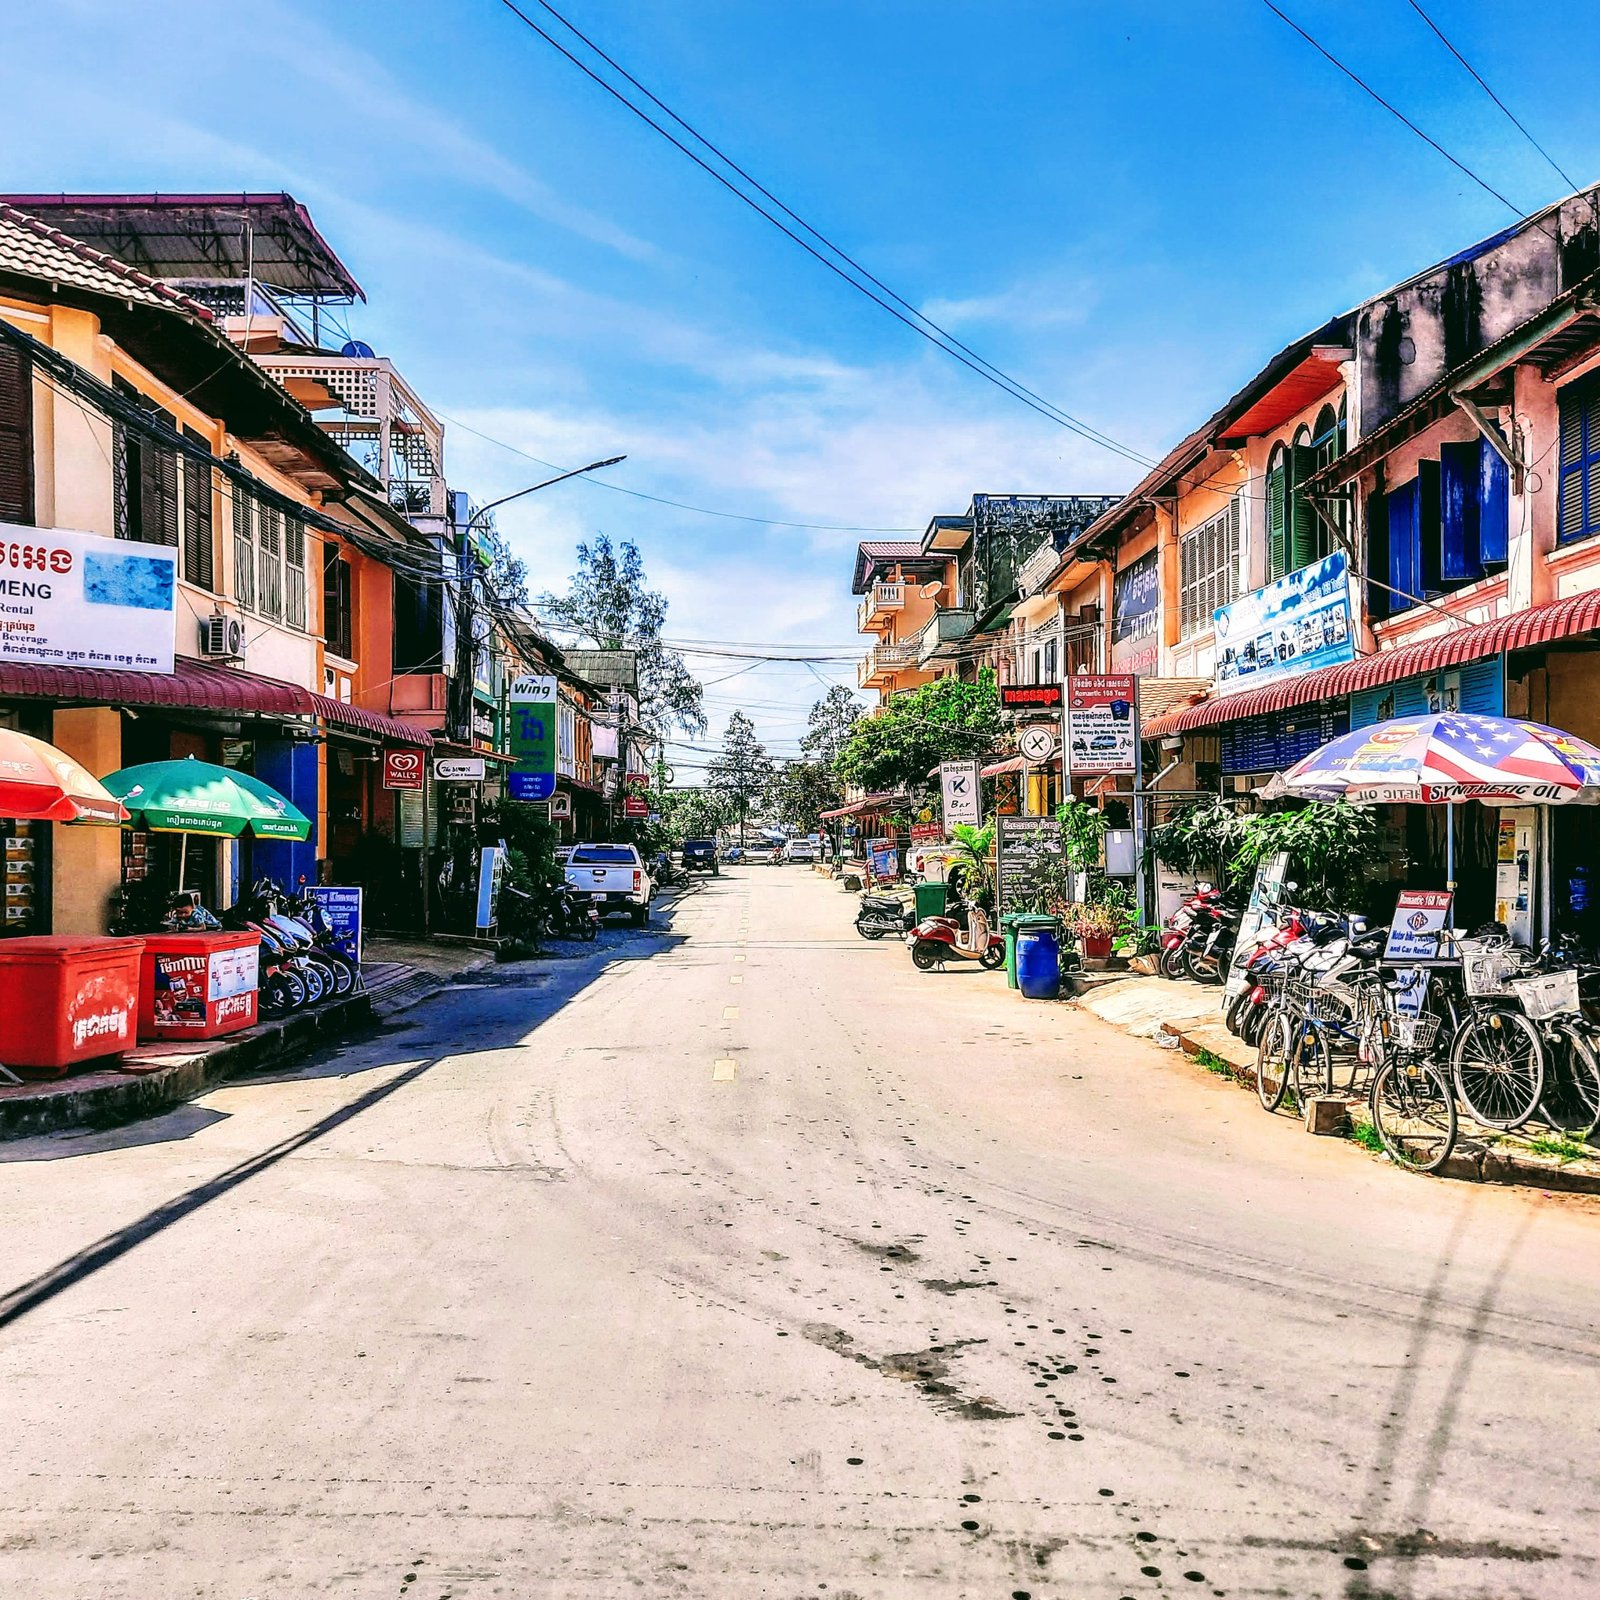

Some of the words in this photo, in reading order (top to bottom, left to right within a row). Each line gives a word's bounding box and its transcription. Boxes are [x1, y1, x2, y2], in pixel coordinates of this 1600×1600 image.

[2, 632, 48, 645] Beverage
[514, 683, 551, 700] Wing
[1004, 688, 1059, 704] massage
[390, 771, 417, 779] WALL'S
[1430, 783, 1530, 800] SYNTHETIC
[1533, 785, 1562, 800] OIL
[950, 800, 970, 808] Bar
[1400, 893, 1424, 905] Romantic
[1436, 895, 1450, 906] Tour
[1391, 929, 1405, 940] Motor
[1389, 945, 1400, 953] and
[1401, 945, 1412, 953] Car
[1413, 946, 1432, 955] Rental
